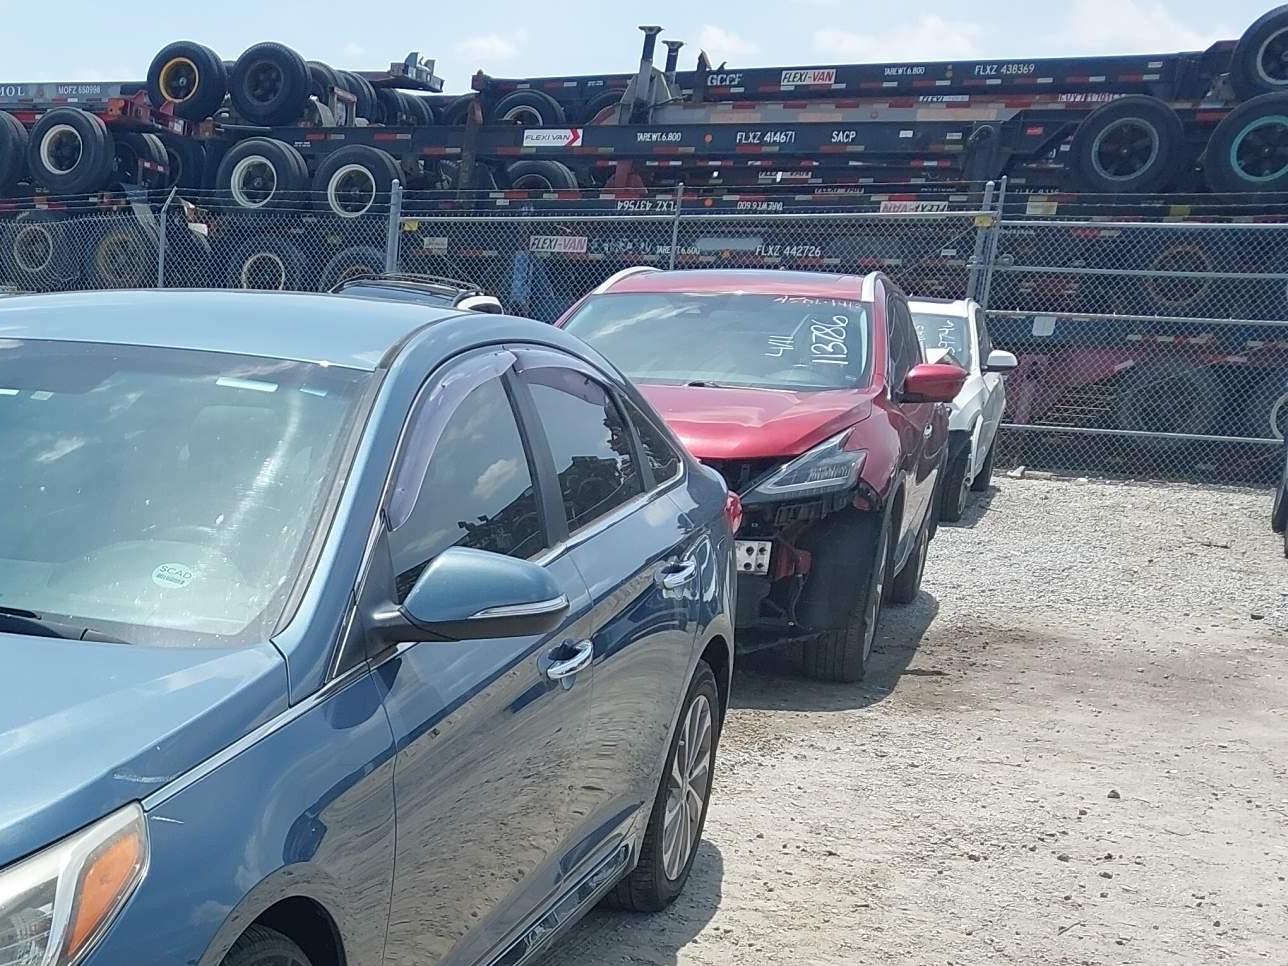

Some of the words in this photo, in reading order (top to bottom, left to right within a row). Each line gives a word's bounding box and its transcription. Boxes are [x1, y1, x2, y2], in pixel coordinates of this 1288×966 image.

[974, 65, 998, 75] FLXZ
[1000, 63, 1035, 74] 438369
[782, 71, 834, 83] FLEXI-VAN
[736, 132, 761, 143] FLXZ
[763, 131, 795, 143] 414671
[831, 131, 856, 143] SACP
[531, 237, 585, 250] FLEXI-VAN
[755, 245, 782, 256] FLXZ
[783, 245, 821, 256] 442726
[159, 565, 192, 579] SCAD
